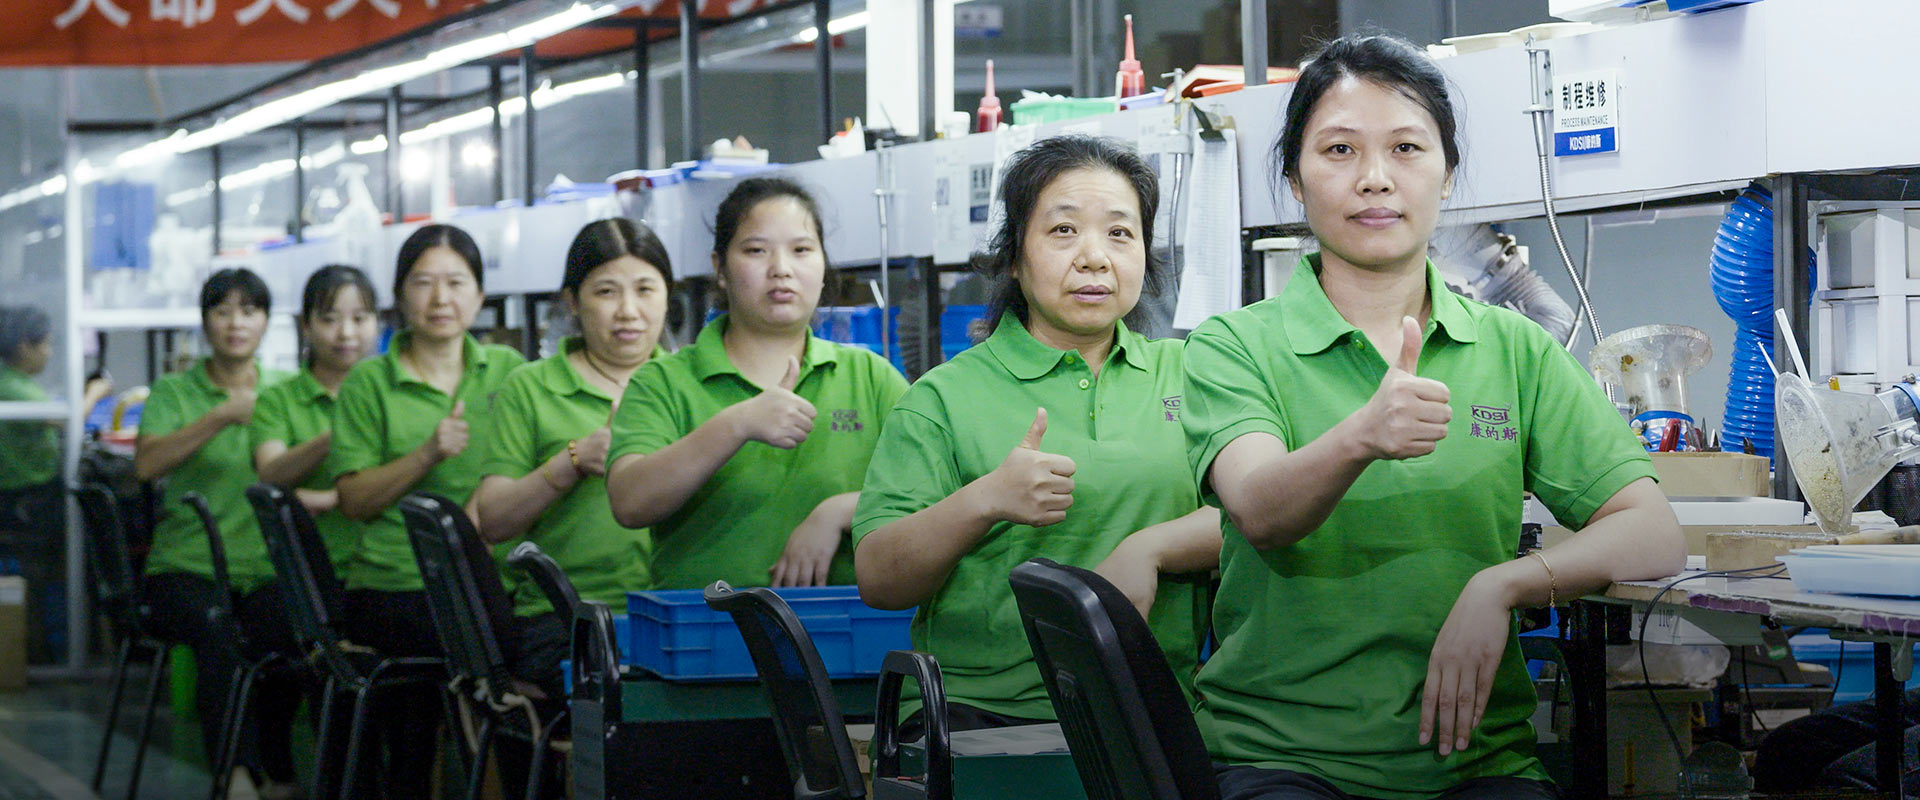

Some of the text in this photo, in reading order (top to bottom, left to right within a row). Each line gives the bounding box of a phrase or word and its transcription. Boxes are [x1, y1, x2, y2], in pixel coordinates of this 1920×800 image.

[1562, 80, 1606, 110] 制程维修
[1472, 407, 1509, 421] KDSI
